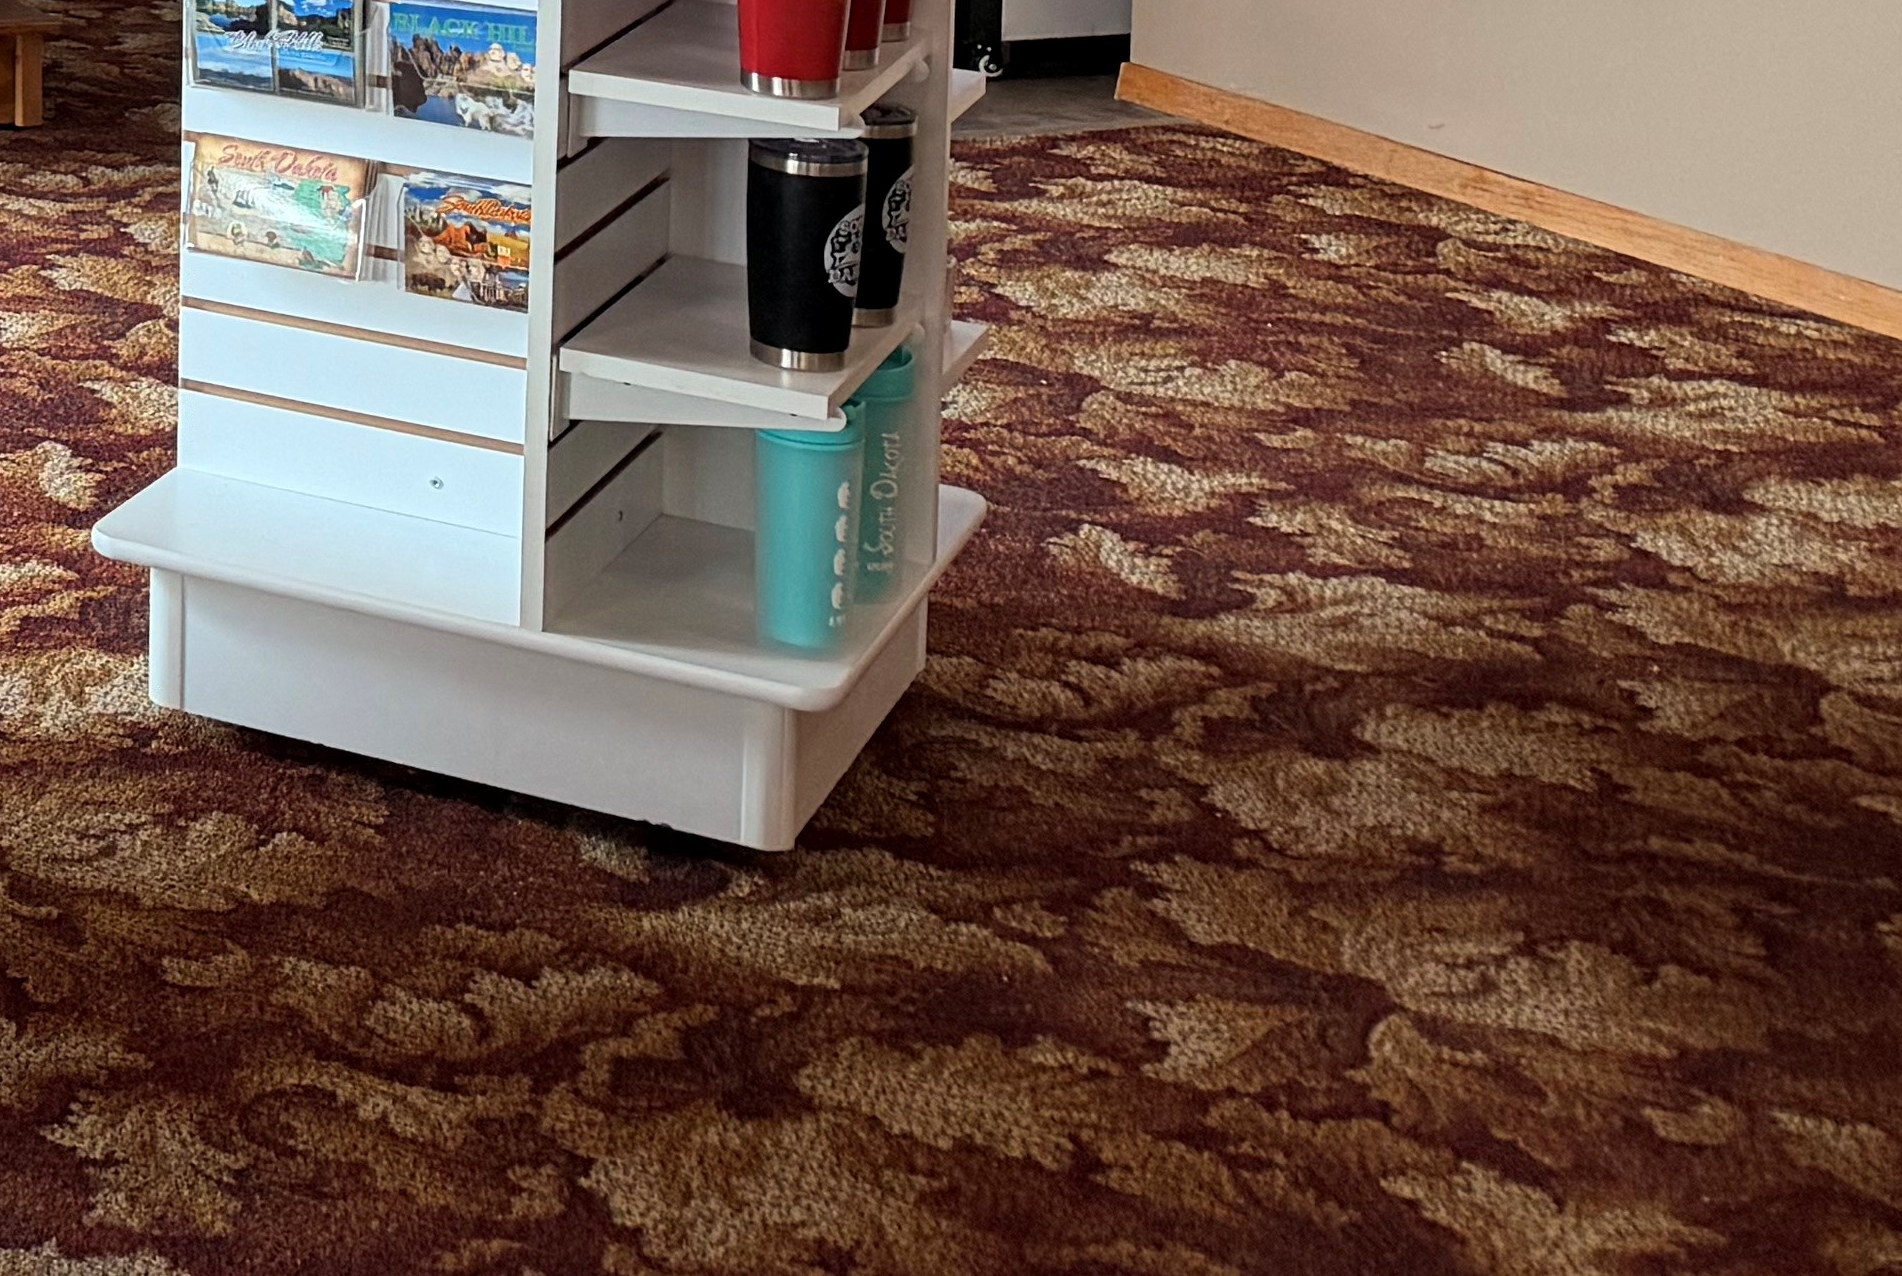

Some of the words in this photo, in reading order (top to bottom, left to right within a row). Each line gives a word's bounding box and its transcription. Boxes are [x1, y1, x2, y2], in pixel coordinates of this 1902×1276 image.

[393, 12, 481, 41] BLACK
[219, 143, 265, 172] South
[273, 150, 339, 183] Dakota
